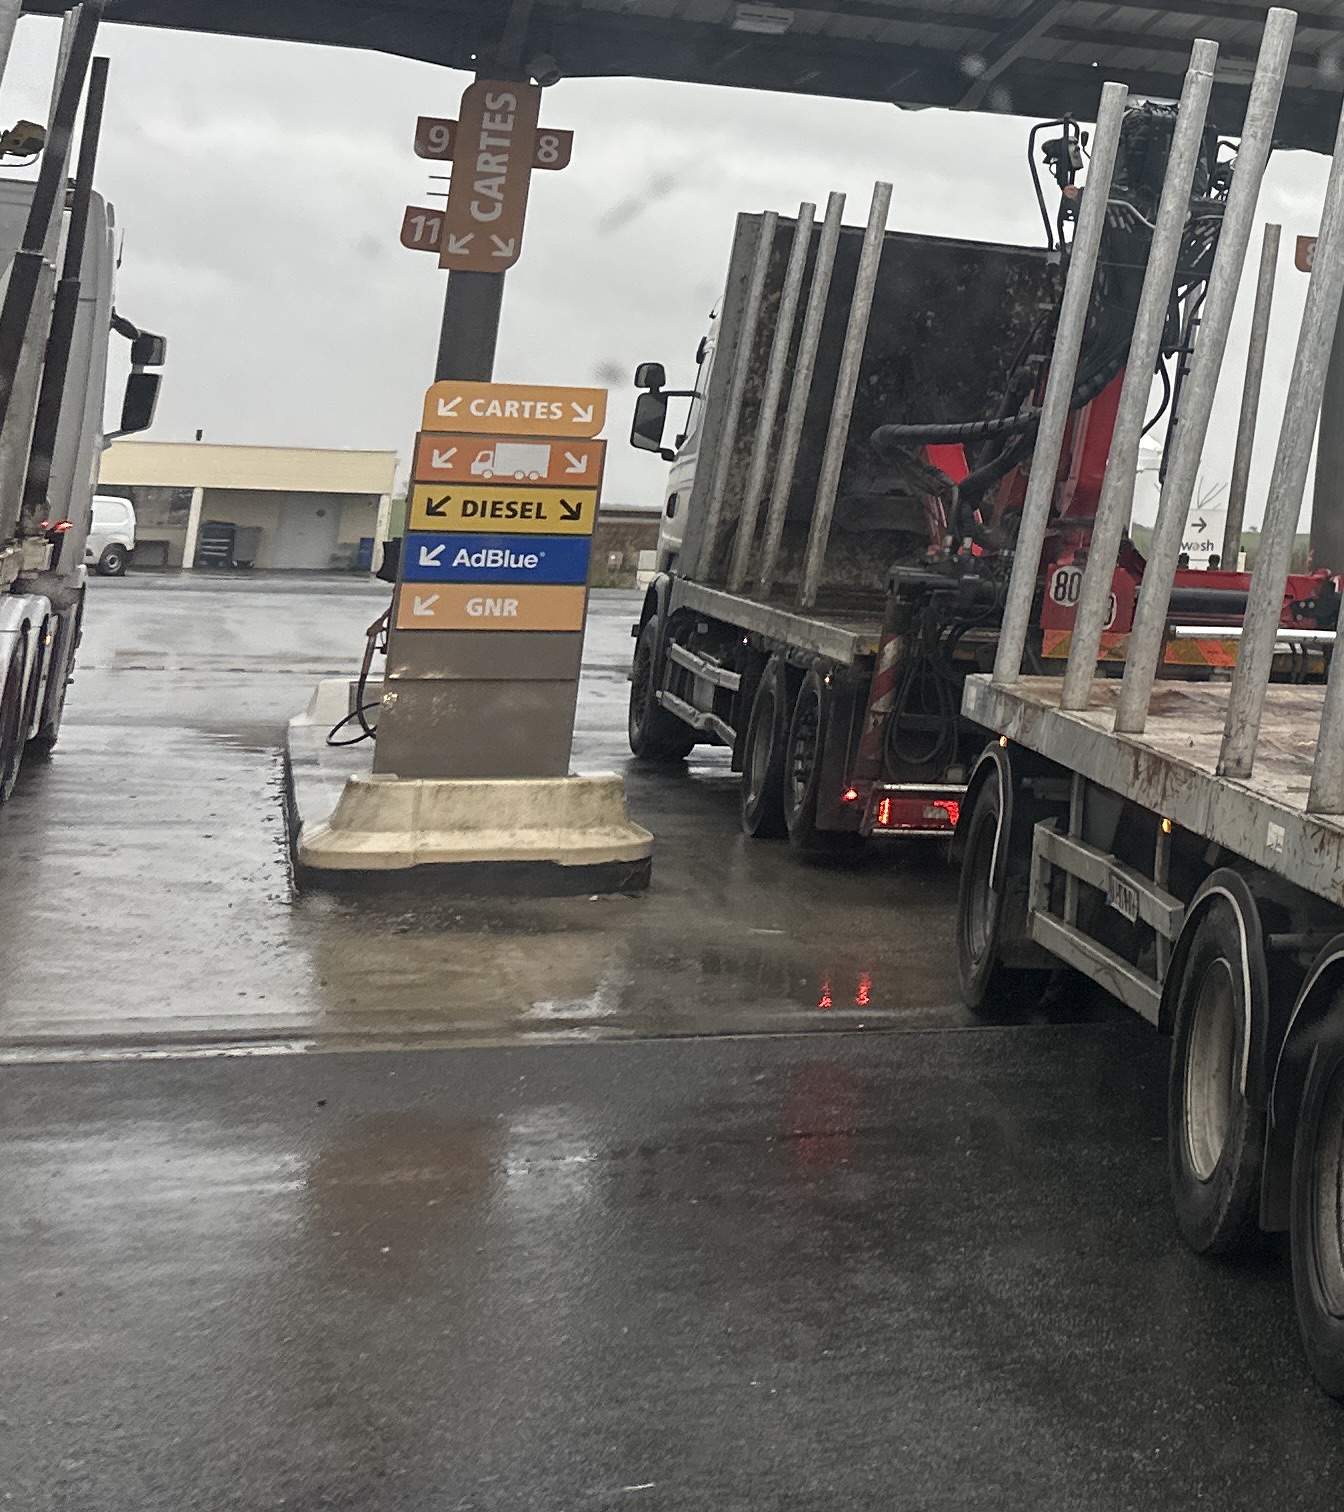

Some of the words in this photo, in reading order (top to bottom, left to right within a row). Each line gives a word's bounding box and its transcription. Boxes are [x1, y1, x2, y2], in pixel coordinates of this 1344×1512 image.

[428, 125, 449, 153] 9
[538, 135, 559, 163] 8
[470, 92, 517, 222] CARTES
[410, 215, 441, 244] 11
[469, 398, 563, 420] CARTES
[461, 499, 548, 520] DIESEL
[1053, 570, 1083, 603] 80
[465, 597, 519, 617] GNR
